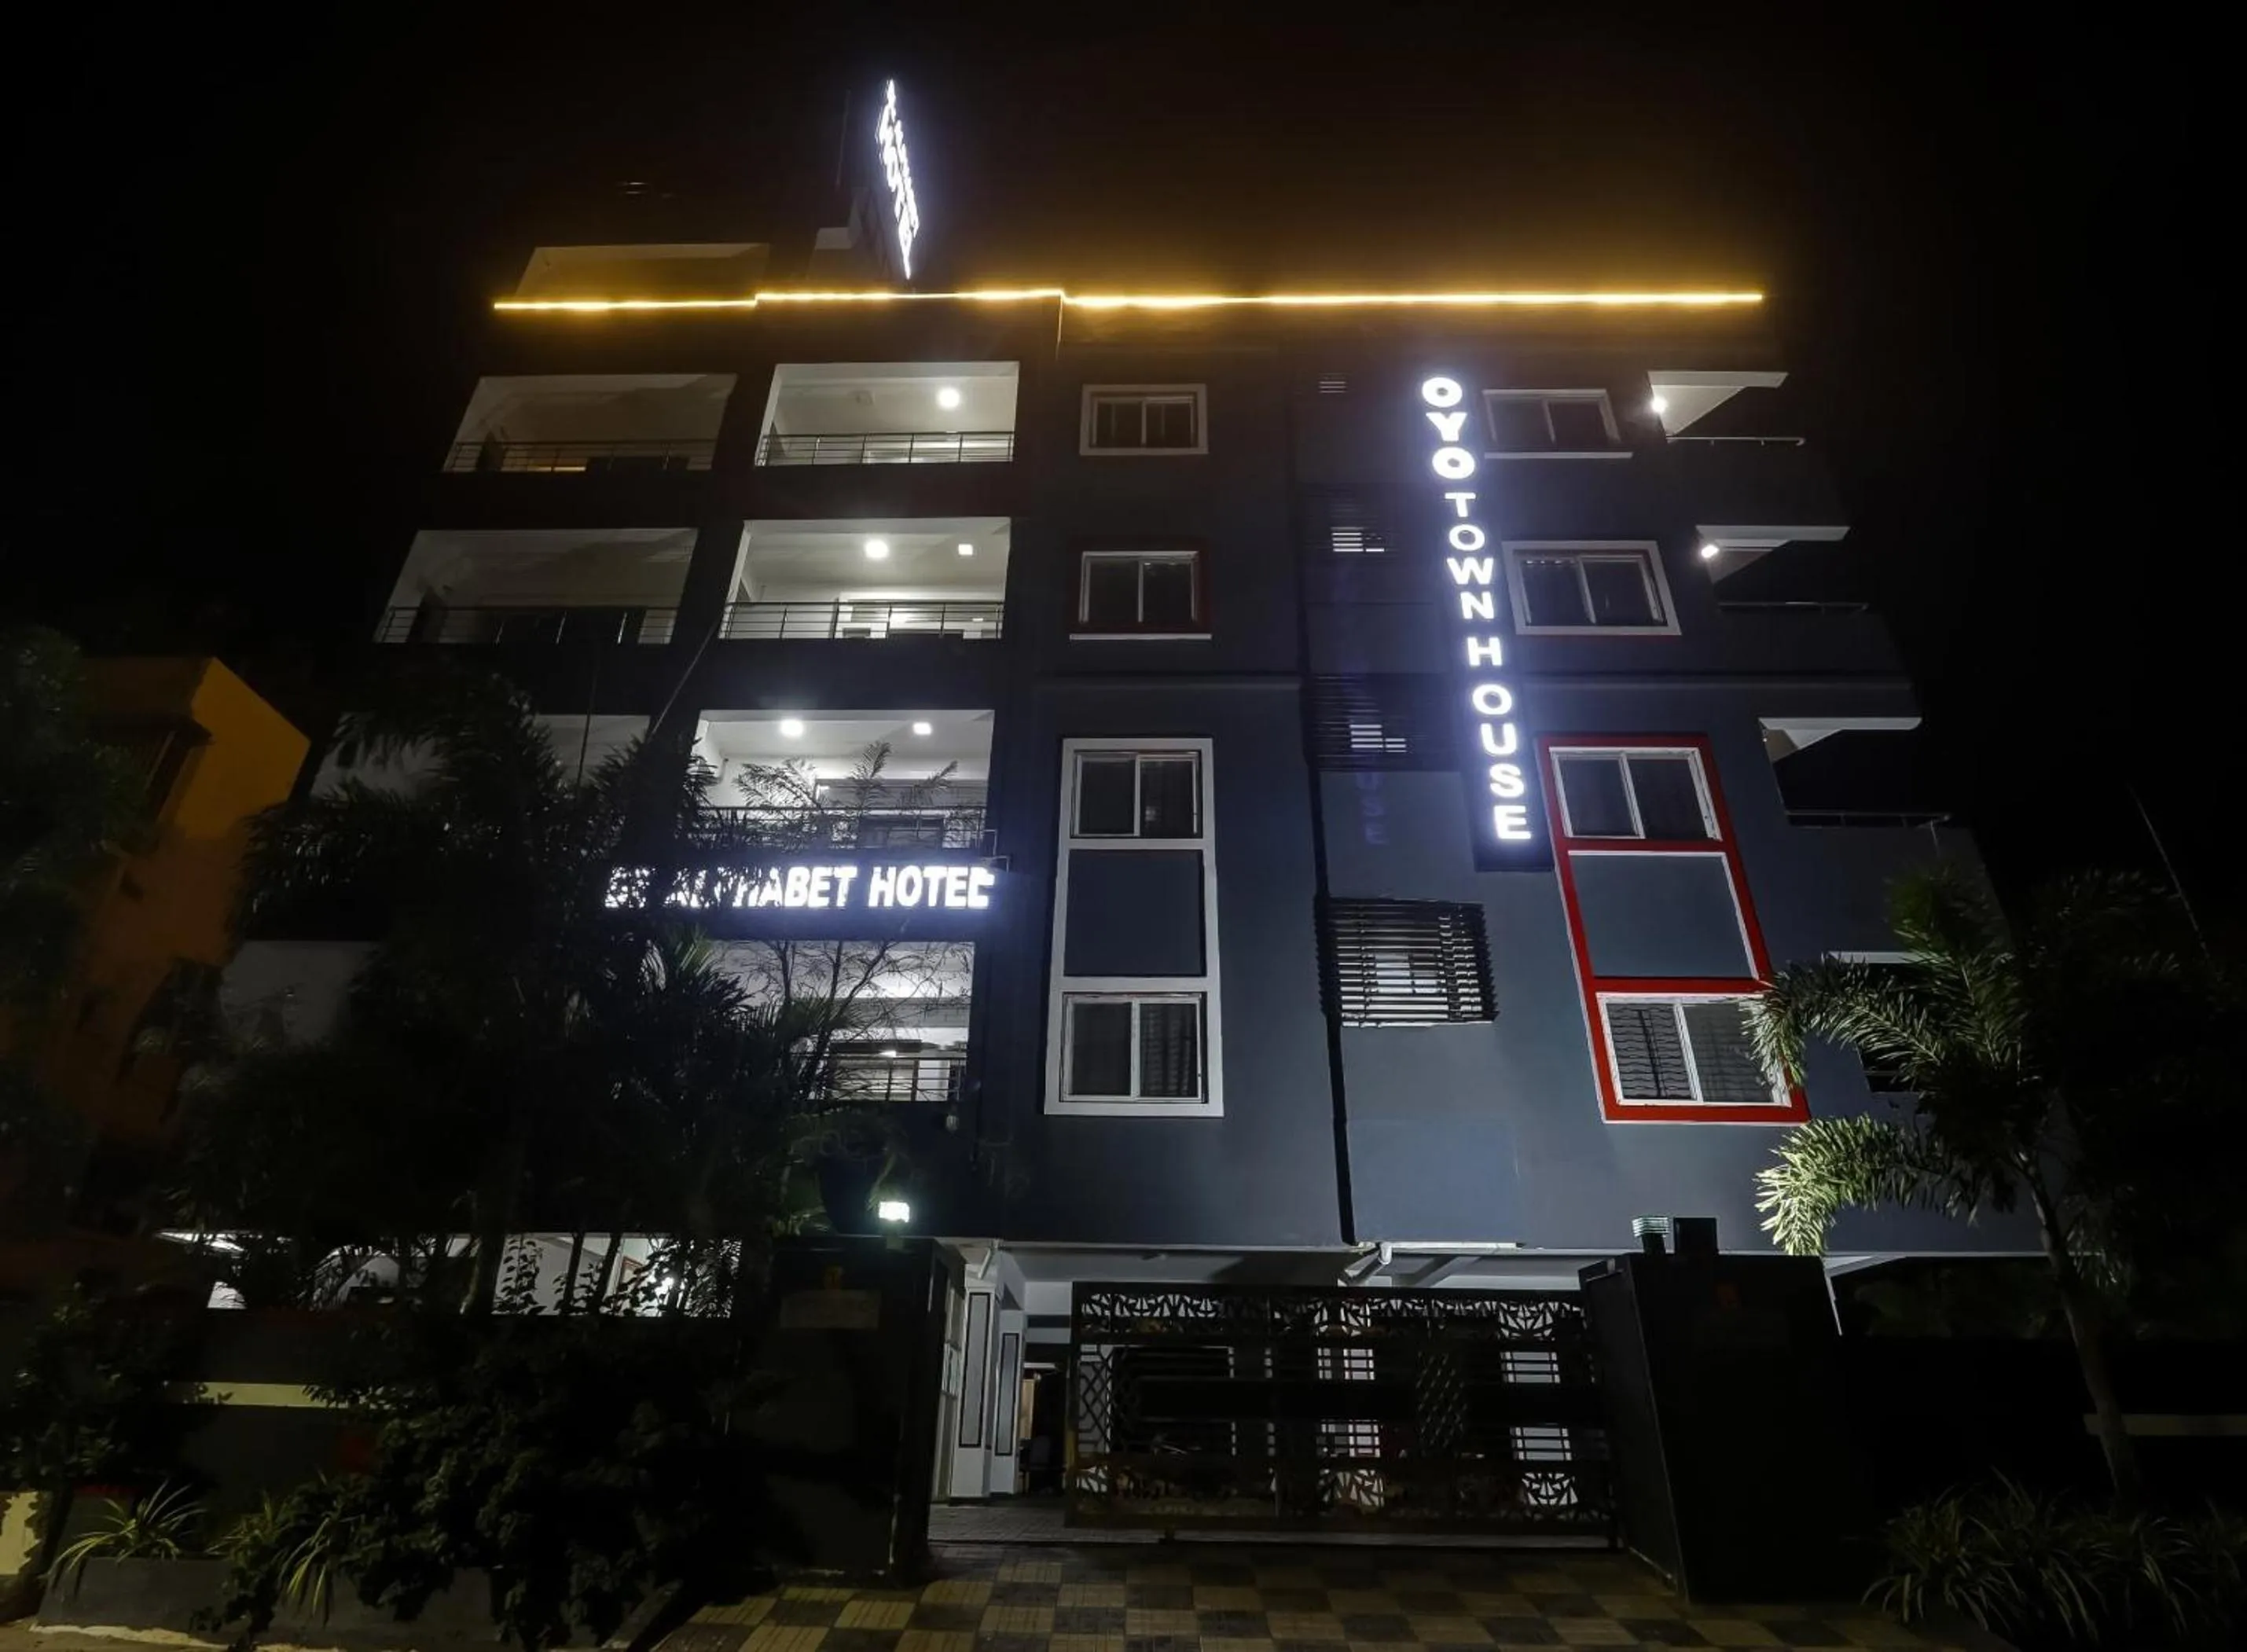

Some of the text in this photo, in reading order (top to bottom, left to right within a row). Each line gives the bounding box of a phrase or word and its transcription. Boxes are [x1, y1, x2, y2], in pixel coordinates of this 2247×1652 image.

[1421, 376, 1532, 840] OYO TOWN HOUSE
[868, 865, 996, 909] HOTEL
